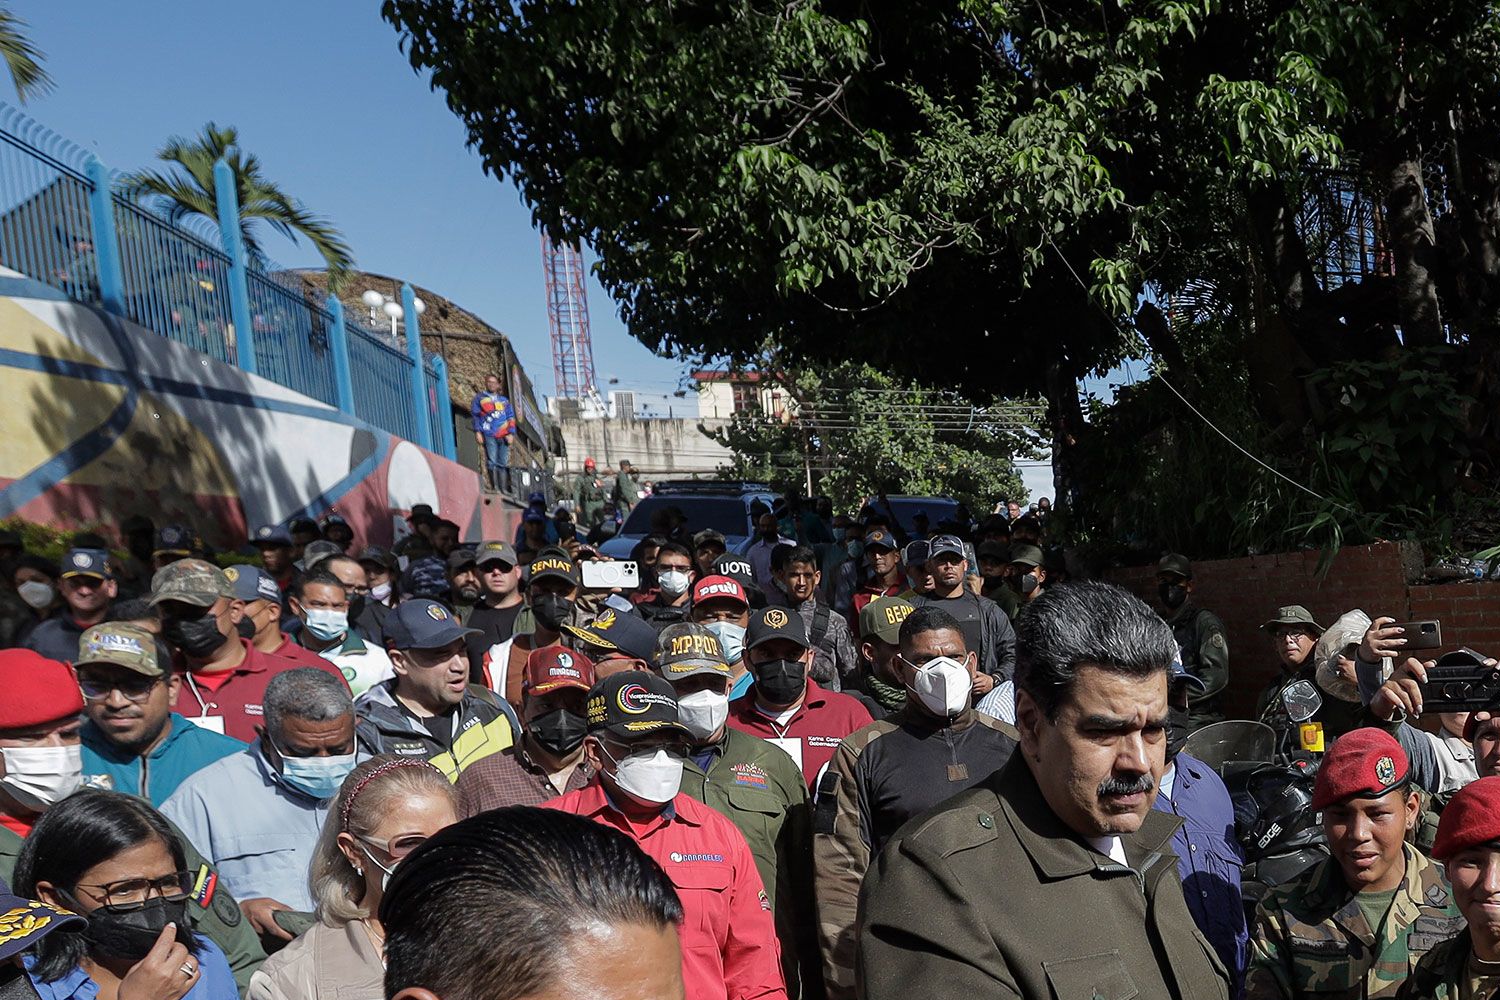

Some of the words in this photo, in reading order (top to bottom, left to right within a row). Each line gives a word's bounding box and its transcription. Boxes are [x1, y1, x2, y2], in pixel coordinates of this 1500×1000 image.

[530, 558, 572, 575] SENIAT
[670, 634, 719, 656] MPPOP
[1257, 822, 1283, 849] EDGE
